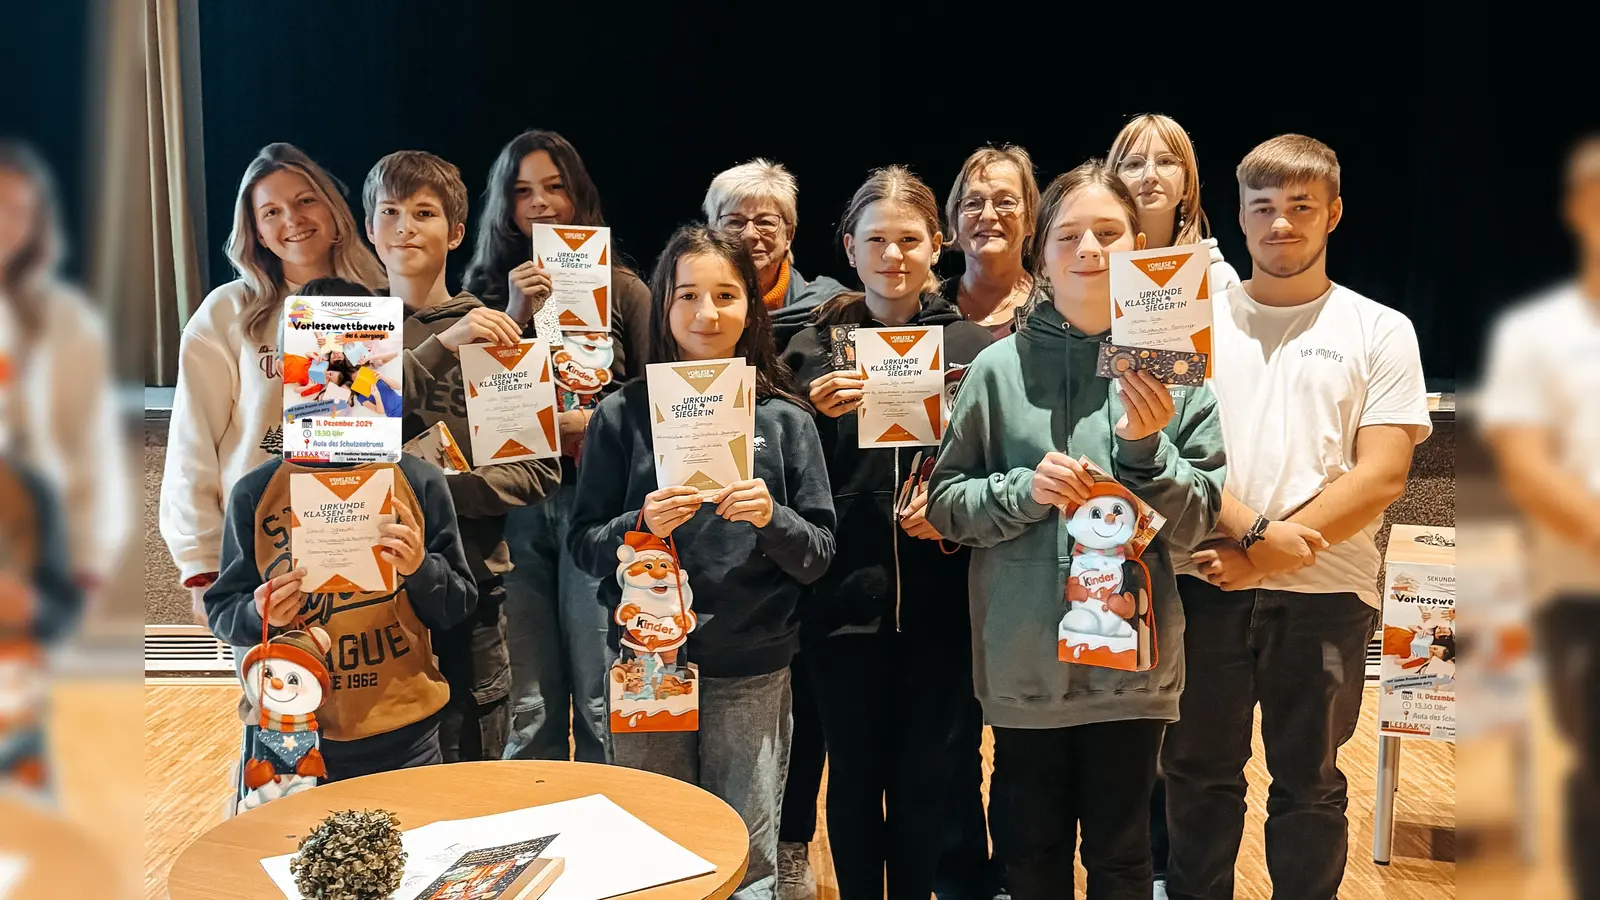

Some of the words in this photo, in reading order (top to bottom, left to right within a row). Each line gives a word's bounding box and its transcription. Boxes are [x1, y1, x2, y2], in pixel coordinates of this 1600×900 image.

[1140, 288, 1182, 299] URKUNDE
[1125, 296, 1162, 307] KLASSEN
[292, 321, 395, 331] Vorlesewettbewerb
[492, 371, 528, 380] URKUNDE
[480, 380, 512, 388] KLASSEN
[684, 395, 723, 404] URKUNDE
[672, 404, 697, 412] SCHUL
[340, 440, 384, 448] Schulzentrums
[320, 502, 365, 510] URKUNDE
[304, 510, 344, 518] KLASSEN
[347, 672, 378, 689] 1962
[1434, 704, 1447, 712] Uhr
[1390, 721, 1419, 730] LESBAR
